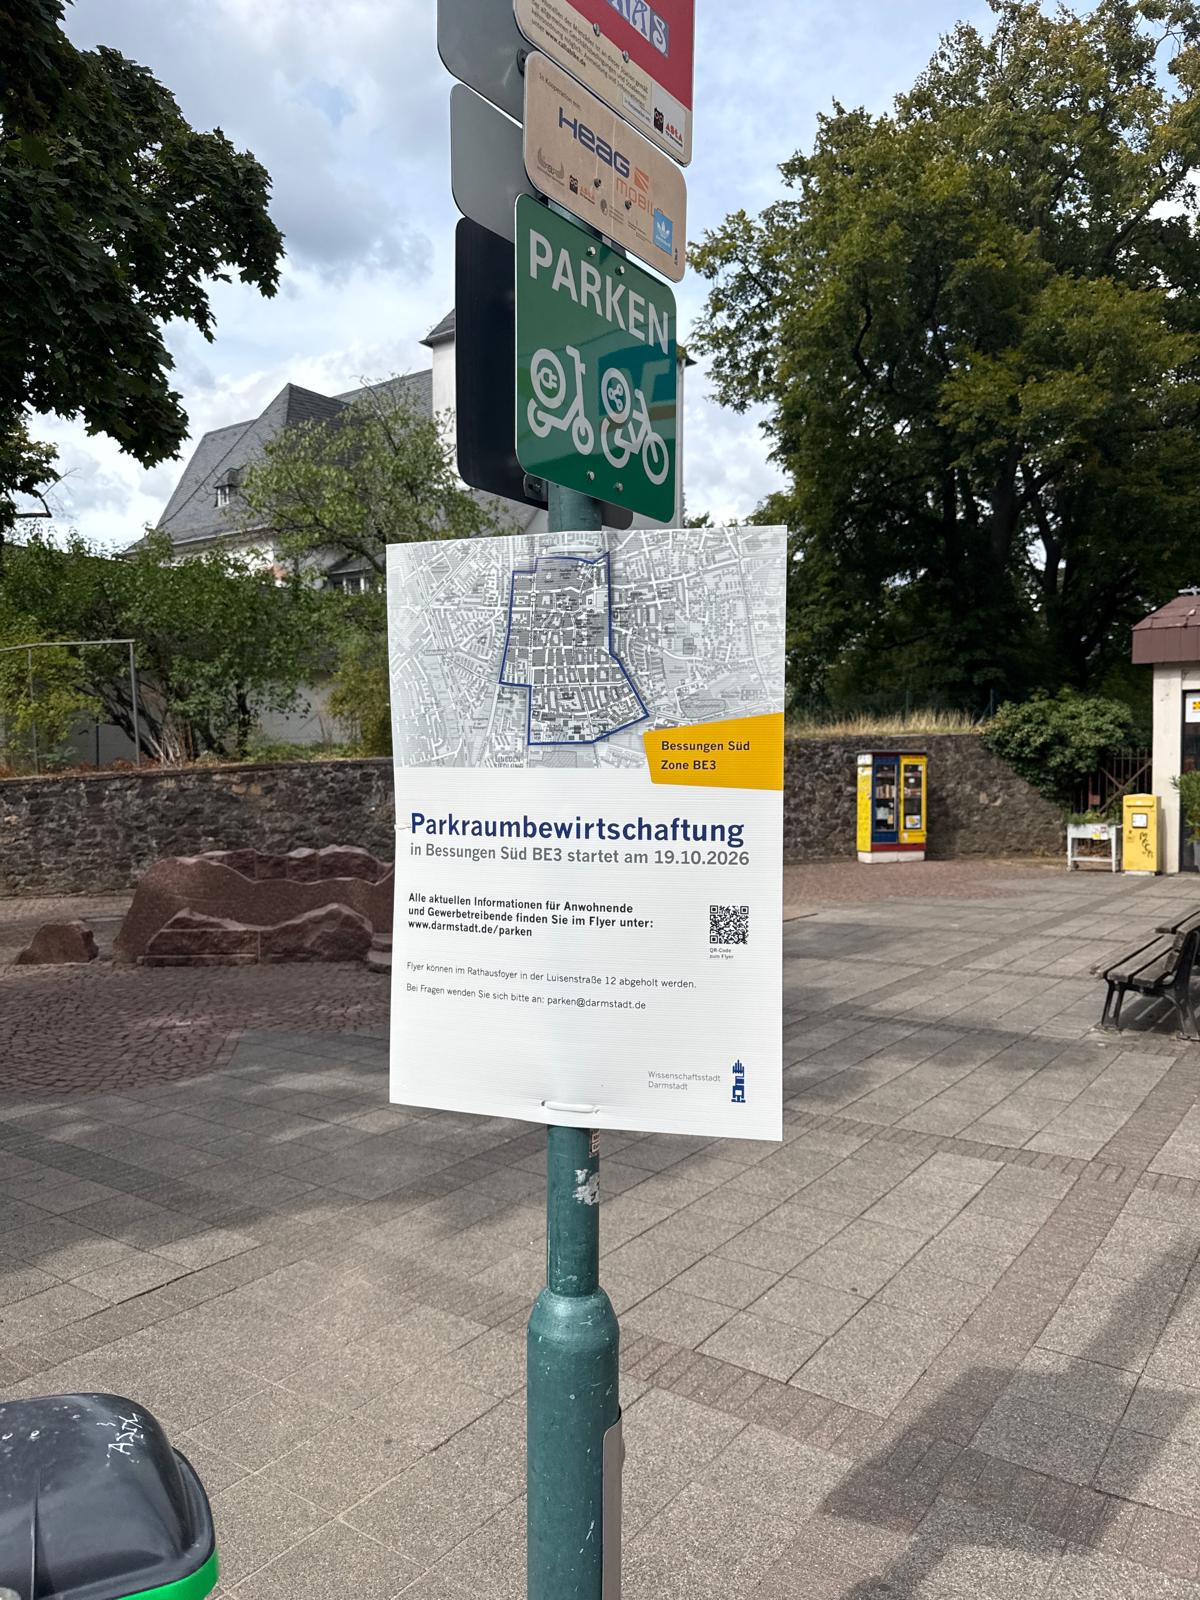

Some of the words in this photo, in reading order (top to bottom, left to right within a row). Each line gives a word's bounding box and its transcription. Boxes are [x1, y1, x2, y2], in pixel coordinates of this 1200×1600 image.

[529, 228, 669, 355] PARKEN
[661, 740, 724, 753] Bessungen
[728, 739, 750, 751] Süd
[661, 760, 689, 770] Zone
[693, 759, 717, 770] BE3
[411, 812, 745, 849] Parkraumbewirtschaftung
[410, 842, 421, 856] in
[426, 843, 496, 862] Bessungen
[500, 846, 527, 861] Süd
[532, 847, 562, 862] BE3
[567, 849, 619, 863] startet
[624, 852, 648, 864] am
[654, 850, 750, 866] 19.10.2026
[408, 892, 426, 903] Alle
[429, 894, 471, 906] aktuellen
[474, 896, 542, 910] Informationen
[546, 900, 560, 910] für
[564, 901, 633, 913] Anwohnende
[408, 906, 425, 916] und
[427, 907, 513, 922] Gewerbetreibende
[516, 912, 548, 924] finden
[551, 914, 569, 925] Sie
[572, 915, 585, 926] im
[589, 916, 616, 928] Flyer
[620, 918, 654, 928] unter:
[408, 920, 533, 937] www.darmstadt.de/parken
[406, 961, 424, 972] Flyer
[426, 963, 453, 974] können
[455, 966, 465, 975] im
[467, 966, 518, 980] Rathausfoyer
[520, 971, 528, 980] in
[530, 972, 544, 981] der
[546, 972, 602, 985] Luisenstraße
[605, 976, 617, 986] 12
[619, 977, 658, 988] abgeholt
[661, 980, 697, 989] werden.
[406, 982, 418, 992] Bei
[420, 984, 444, 996] Fragen
[447, 988, 476, 998] wenden
[478, 989, 490, 999] Sie
[492, 992, 508, 1001] sich
[510, 993, 529, 1003] bitte
[532, 995, 544, 1004] an:
[547, 996, 646, 1010] parken@darmstadt.de
[647, 1070, 721, 1082] Wissenschaftsstadt
[648, 1080, 688, 1091] Darmstadt
